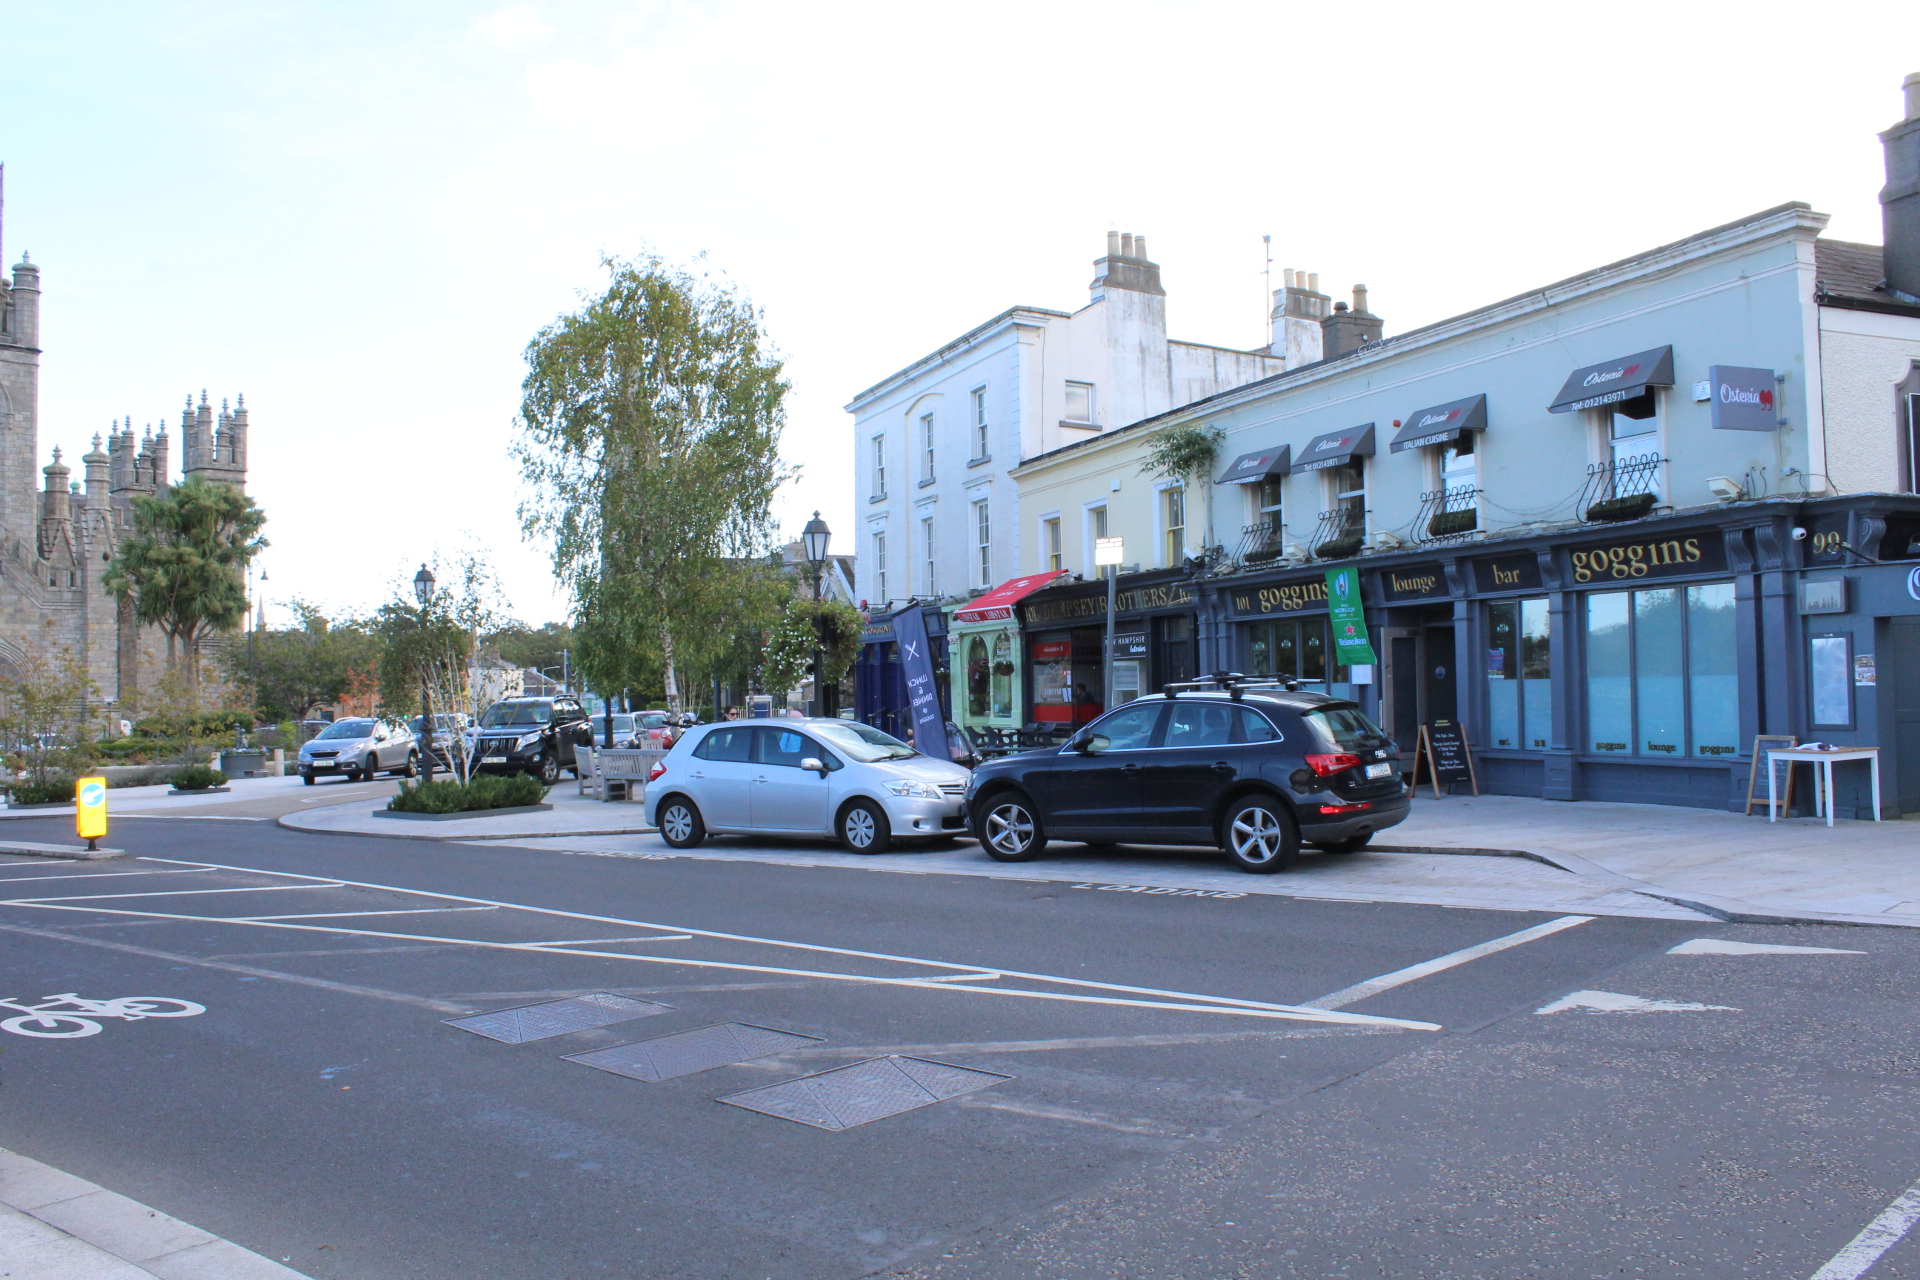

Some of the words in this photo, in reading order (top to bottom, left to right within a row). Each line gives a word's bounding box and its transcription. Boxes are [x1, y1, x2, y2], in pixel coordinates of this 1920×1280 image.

[1583, 367, 1625, 387] Osteria
[1584, 390, 1626, 408] 012143971
[1720, 383, 1760, 404] Osteria
[1403, 437, 1425, 450] ITALIAN
[1425, 432, 1449, 445] CUISINE
[1572, 538, 1701, 582] goggins
[1391, 573, 1436, 593] lounge
[1492, 564, 1520, 584] bar
[1258, 581, 1329, 613] goggins
[1338, 637, 1367, 646] Heineken
[1647, 741, 1676, 753] lounge
[1699, 745, 1736, 756] goggins
[1070, 883, 1249, 899] LOADING
